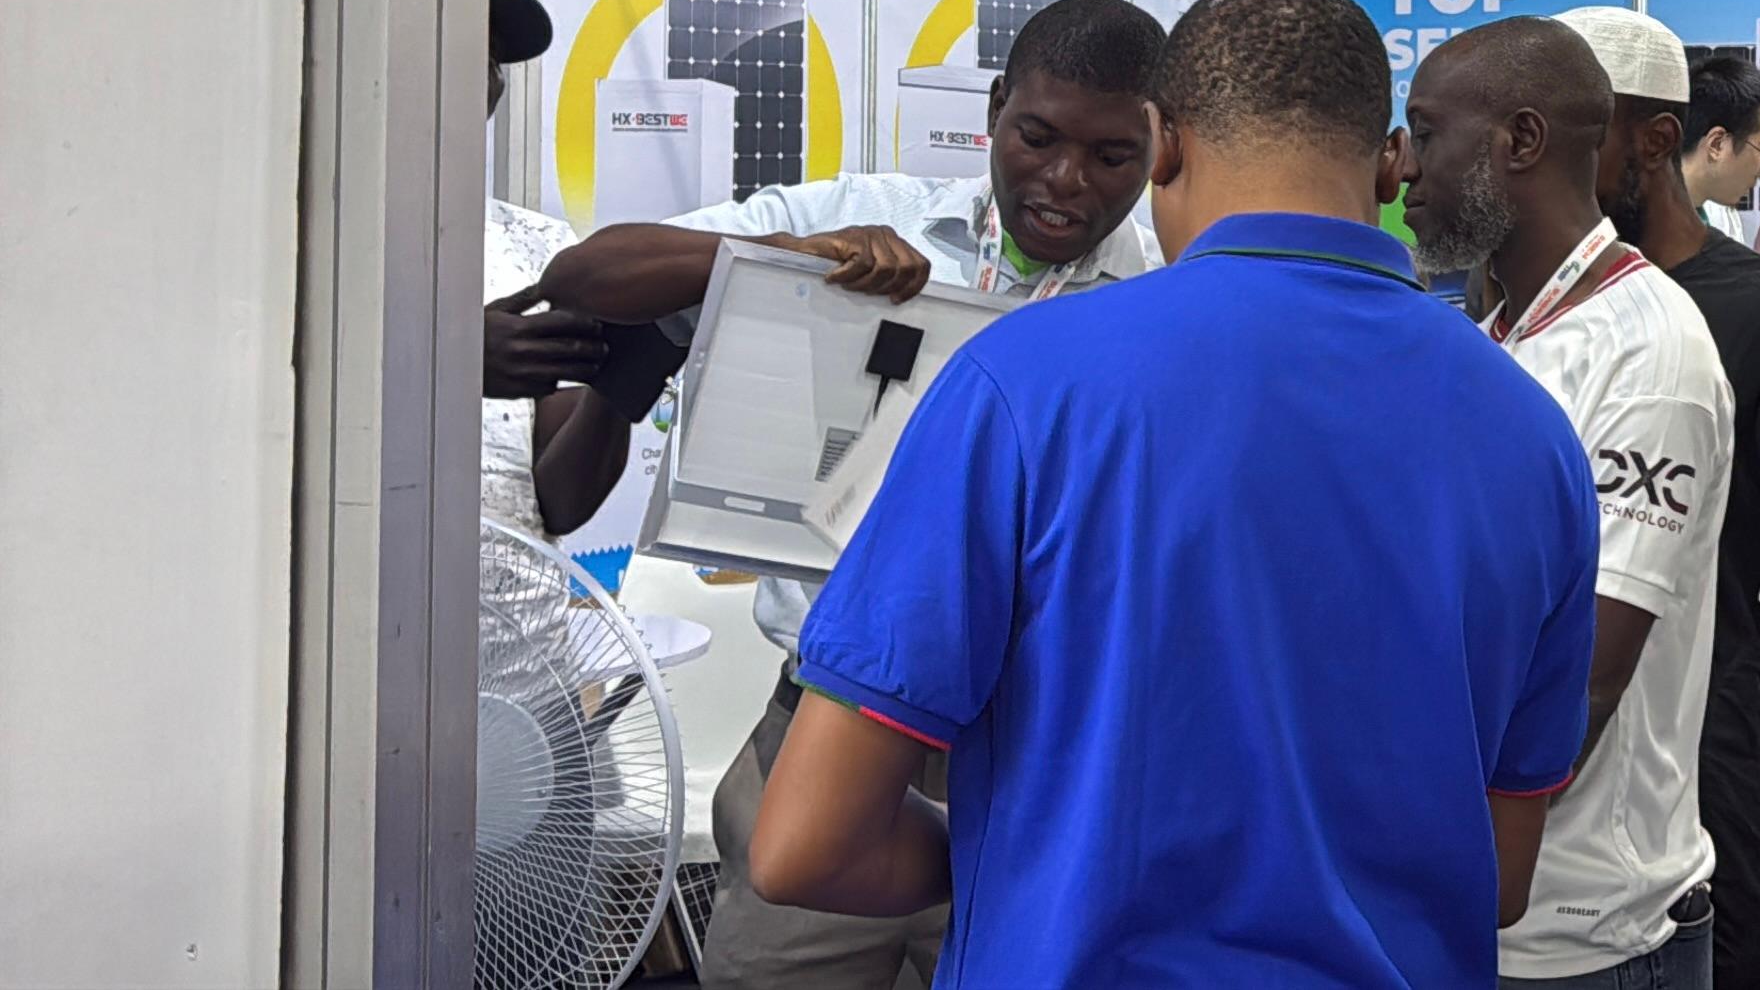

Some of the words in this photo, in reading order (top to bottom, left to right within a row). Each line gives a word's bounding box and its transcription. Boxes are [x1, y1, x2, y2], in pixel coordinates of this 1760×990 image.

[1383, 28, 1465, 71] SE
[1595, 449, 1696, 516] DXC
[1597, 501, 1685, 535] CHNOLOGY
